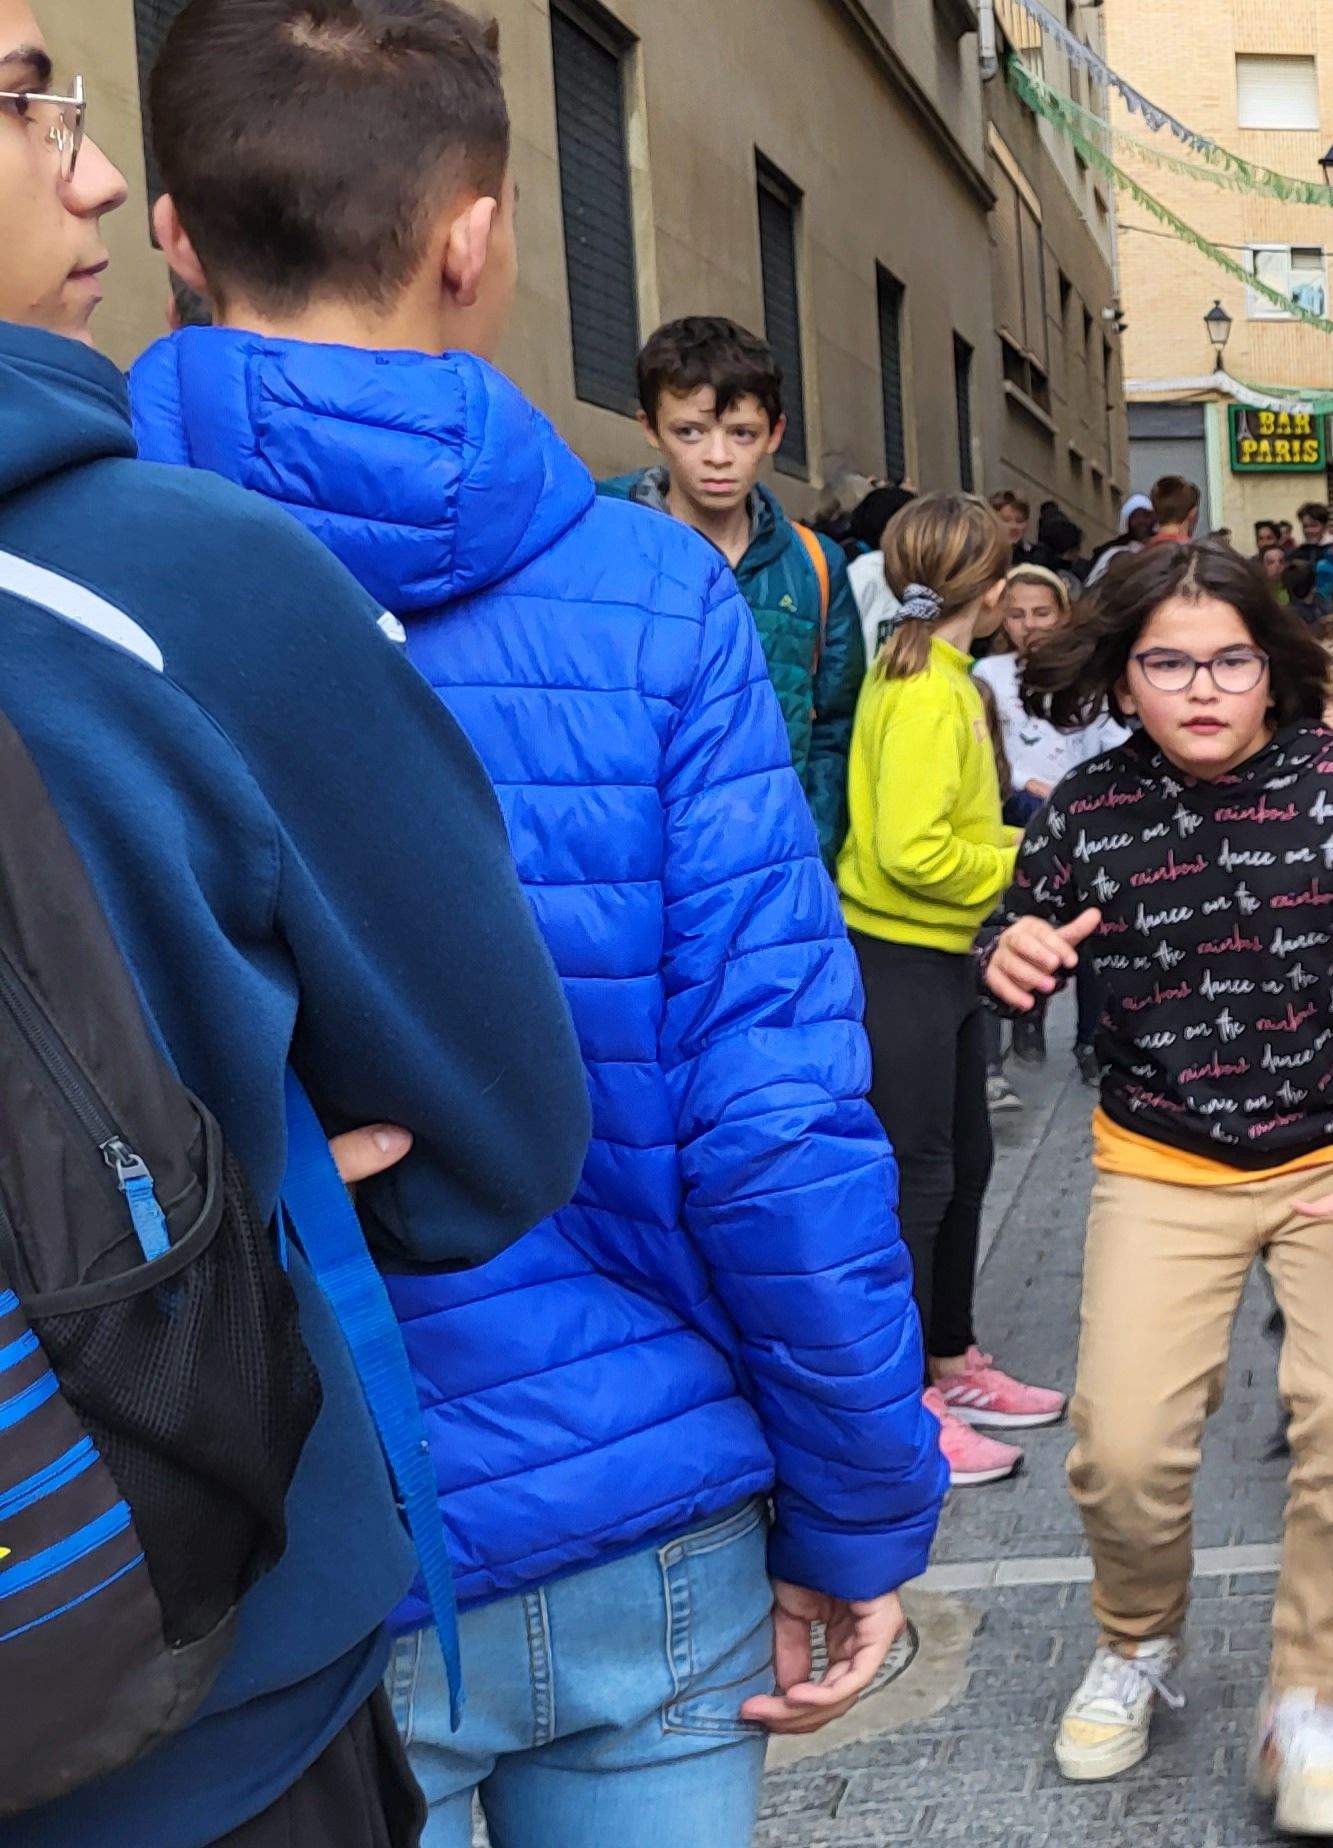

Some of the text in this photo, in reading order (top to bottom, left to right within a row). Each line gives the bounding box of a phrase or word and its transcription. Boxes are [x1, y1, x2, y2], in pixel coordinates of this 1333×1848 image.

[1258, 411, 1312, 435] BAR
[1240, 438, 1319, 463] PARIS
[1072, 828, 1135, 864] dance
[1141, 822, 1171, 842] on
[1171, 802, 1204, 839] the
[1134, 901, 1194, 937] dance
[1201, 895, 1233, 915] on
[1199, 968, 1256, 1002] dance
[1184, 1022, 1213, 1041] on
[1215, 1007, 1246, 1044] the
